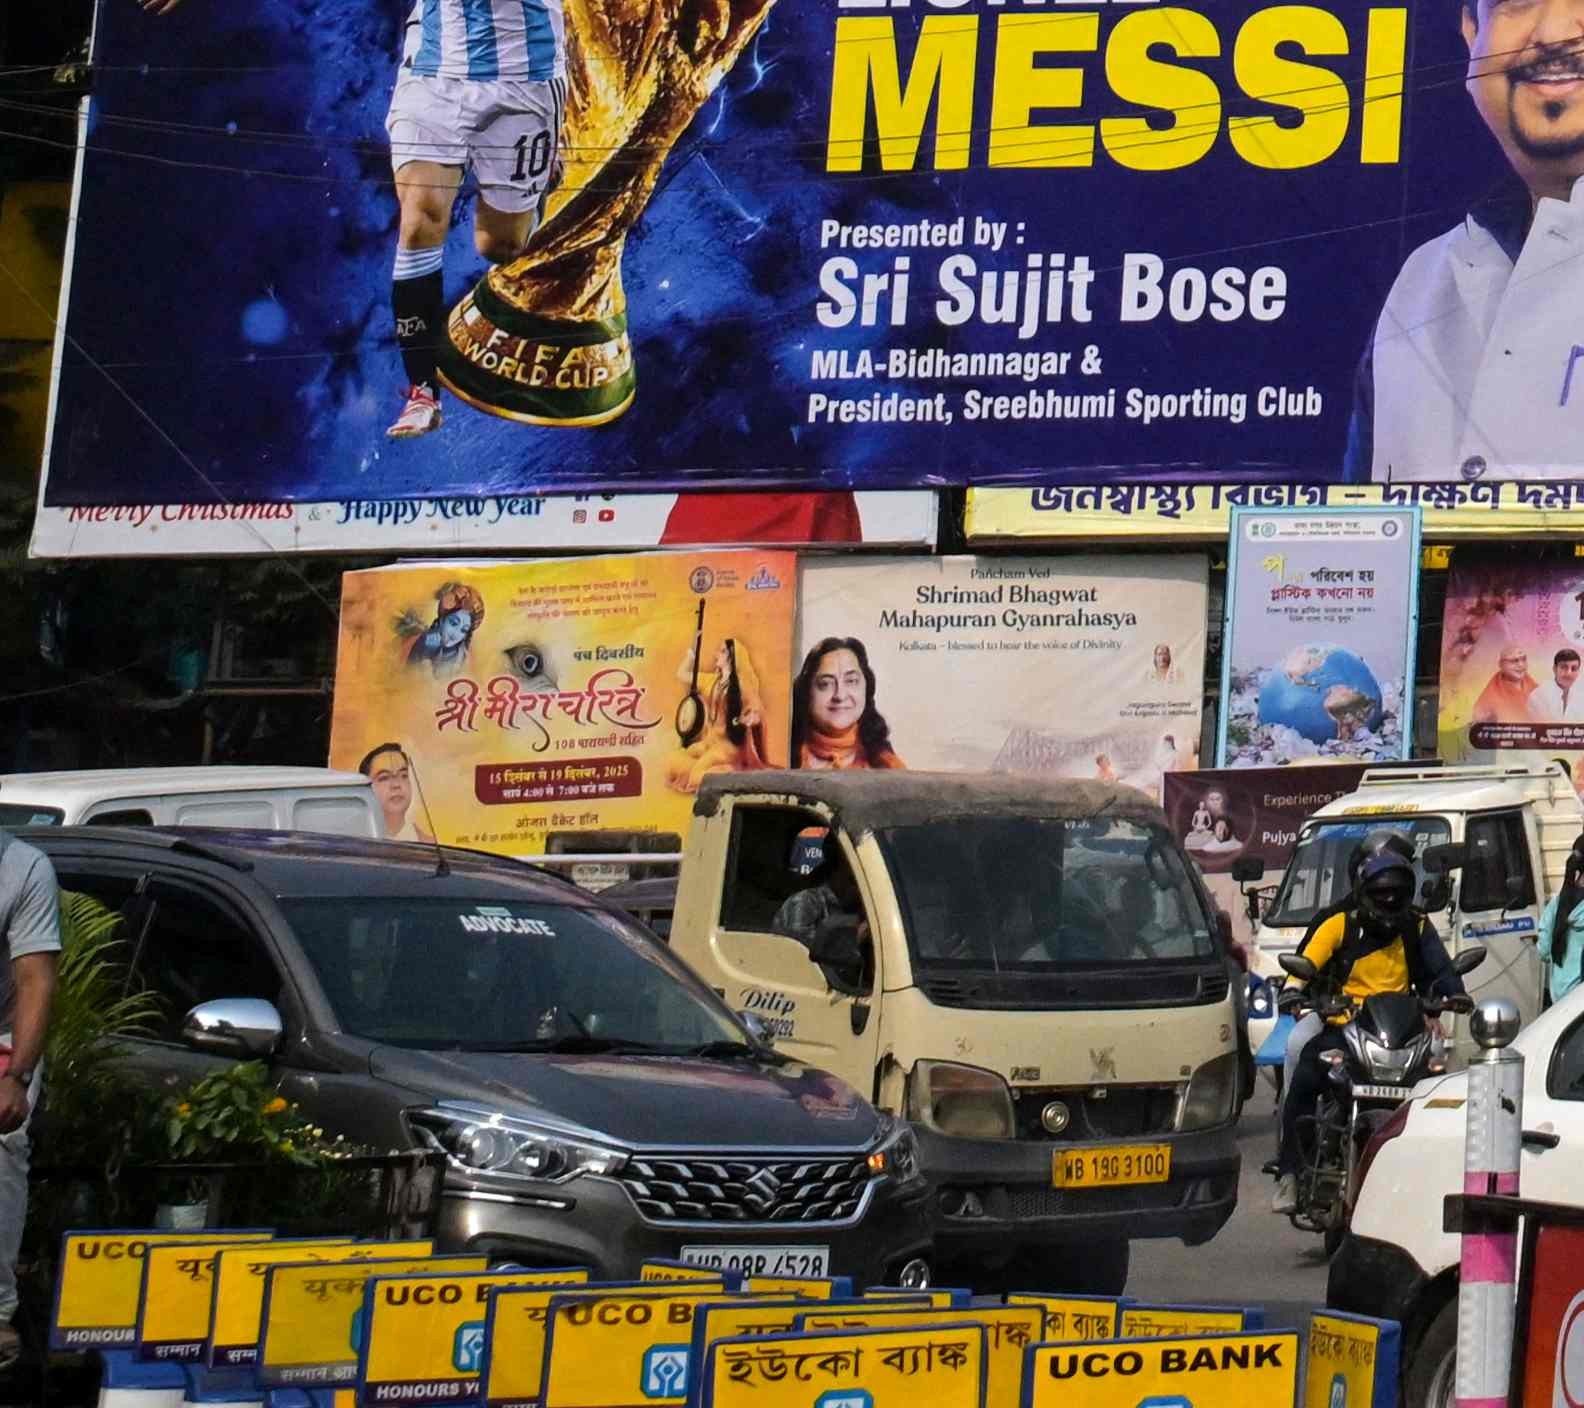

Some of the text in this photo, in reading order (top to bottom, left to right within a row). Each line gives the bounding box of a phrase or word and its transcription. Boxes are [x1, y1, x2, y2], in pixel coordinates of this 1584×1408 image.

[826, 5, 1407, 172] MESSI
[512, 129, 551, 183] 10
[821, 216, 1007, 251] Presented by
[815, 252, 1288, 339] Sri Sujit Bose
[486, 328, 583, 368] FIFA
[463, 338, 609, 389] WORLD CUP
[810, 346, 1102, 381] MLA-Bidhannagar &
[808, 385, 1323, 426] President, Sreebhumi Sporting Club
[336, 496, 546, 525] Happy New Year
[1310, 566, 1376, 584] পরিবেশ হয়
[916, 584, 1099, 606] Shrimad Bhagwat
[1270, 584, 1312, 602] প্লাস্টিক
[1316, 586, 1353, 600] কখনো
[878, 608, 1138, 633] Mahapuran Gyanrahasya
[898, 640, 938, 652] Kolkata
[436, 668, 663, 753] श्री मीरा चरित्र
[603, 764, 630, 778] 2025
[1264, 792, 1332, 808] Experience
[1262, 831, 1297, 846] Pujya
[459, 913, 556, 937] ADVOCATE
[739, 987, 796, 1017] Dilip
[1124, 1152, 1165, 1177] 3100
[385, 1284, 462, 1306] UCO
[722, 1339, 970, 1389] ইউকো ব্যাঙ্ক
[1049, 1342, 1283, 1380] UCO BANK
[376, 1383, 460, 1400] HONOURS
